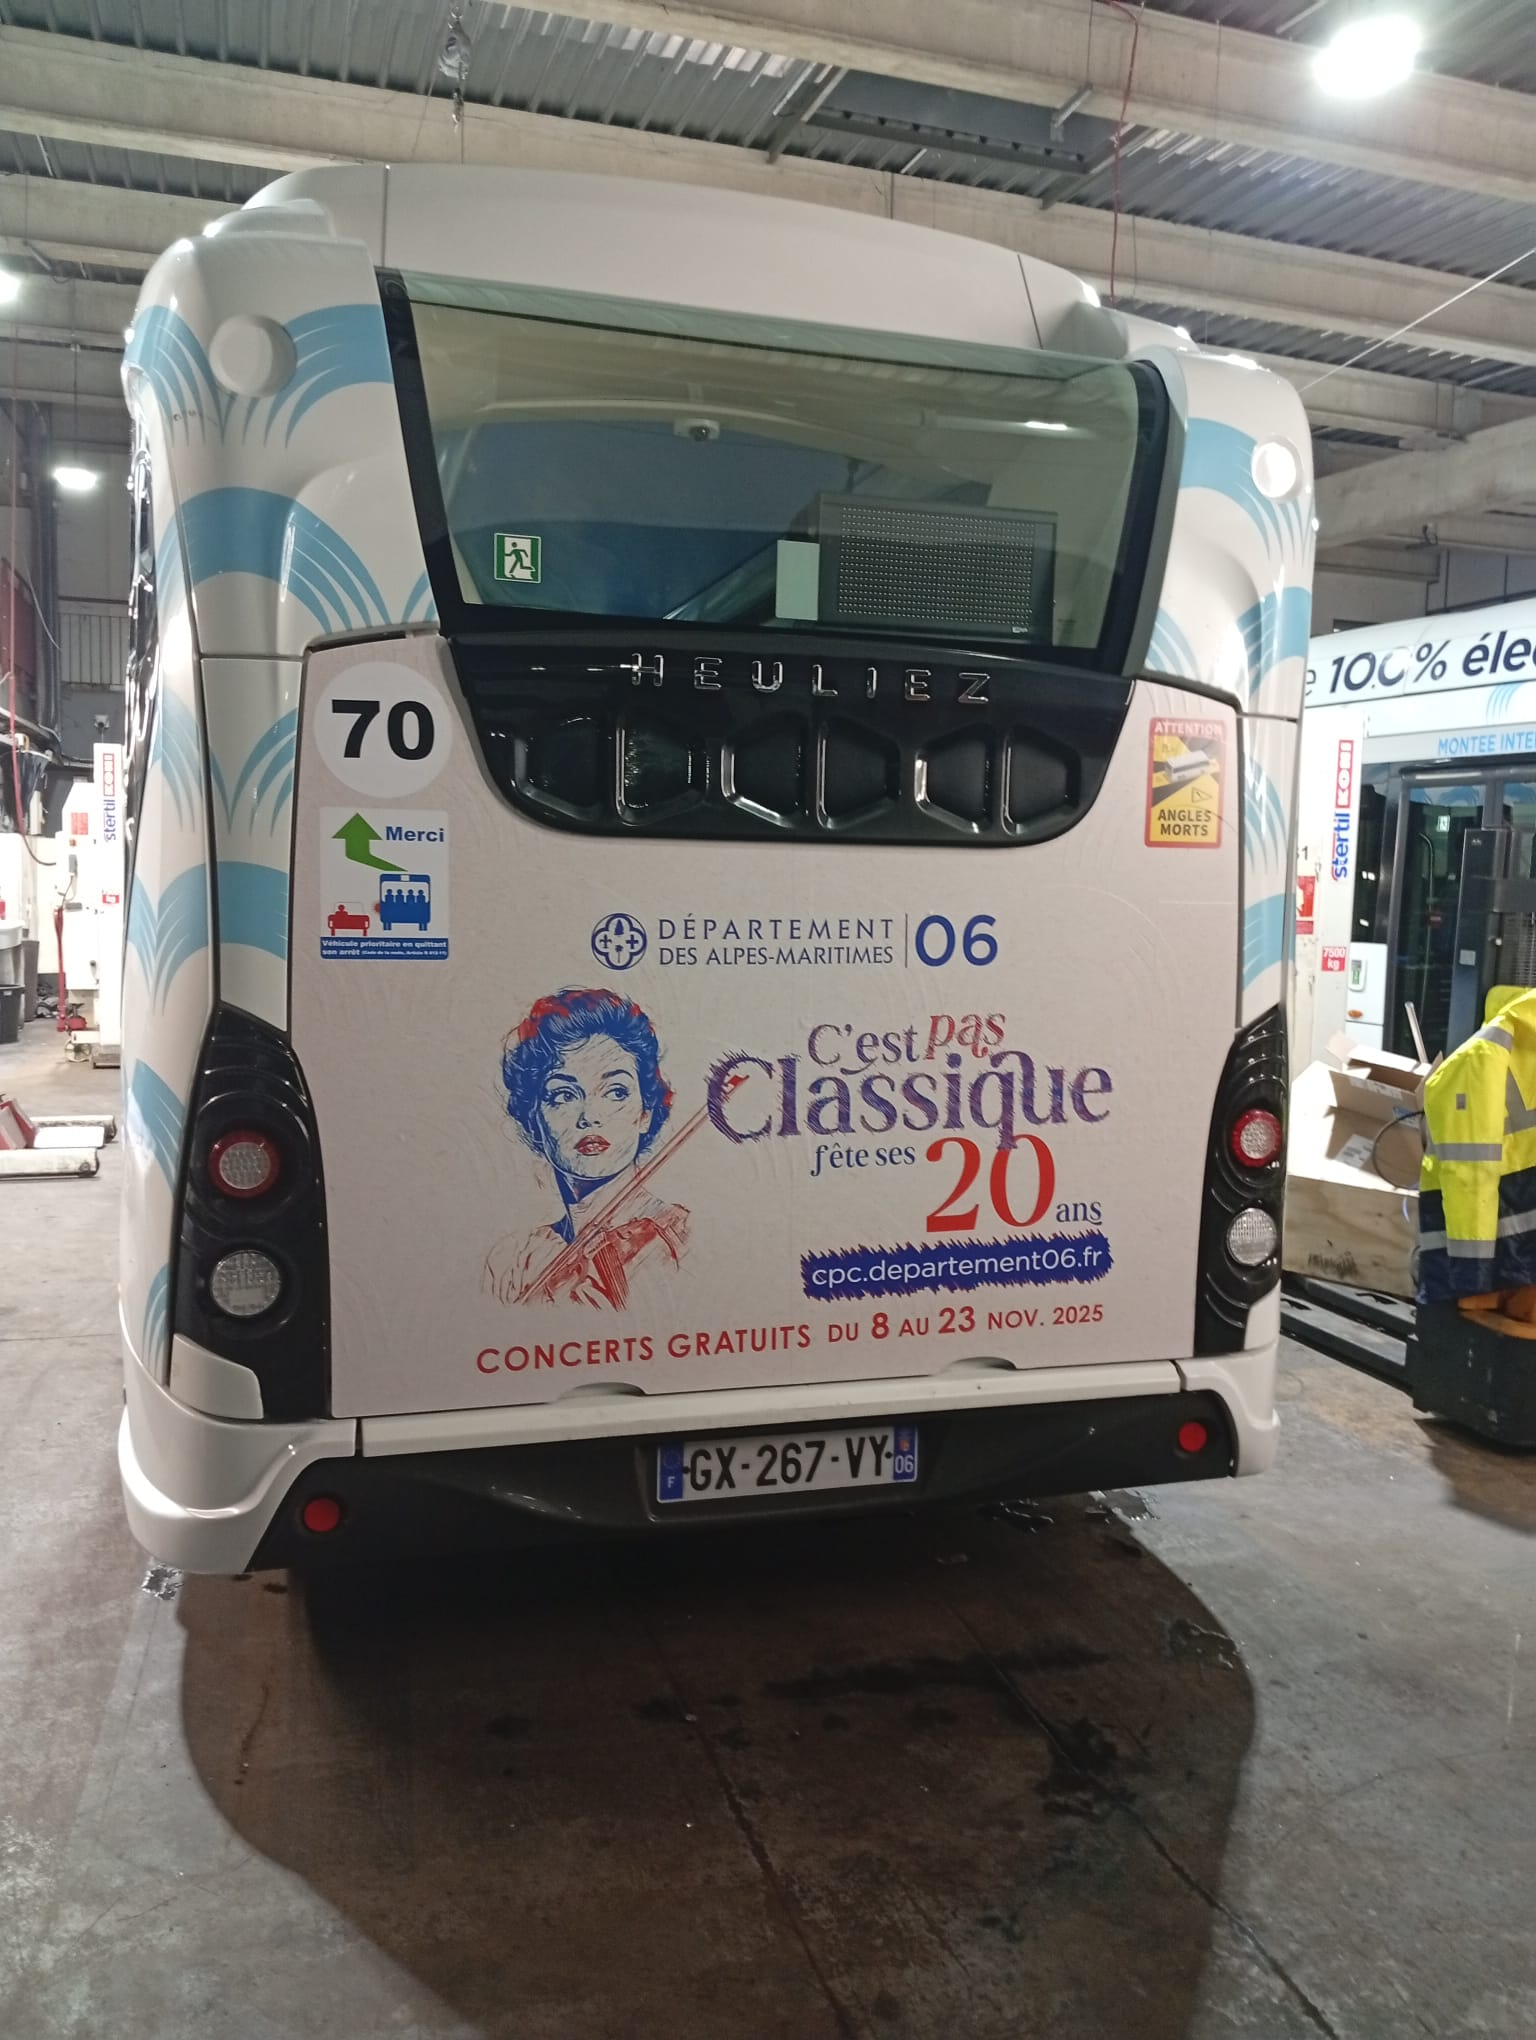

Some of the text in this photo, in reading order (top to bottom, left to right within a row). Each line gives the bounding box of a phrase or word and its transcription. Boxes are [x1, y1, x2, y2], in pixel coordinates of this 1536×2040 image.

[632, 653, 989, 703] HEULIEZ
[1330, 640, 1452, 694] 100%
[1462, 630, 1536, 677] éle
[332, 699, 435, 761] 70
[1154, 722, 1223, 736] ATTENTION
[1438, 731, 1536, 756] MONTEE INTE
[104, 799, 116, 842] stertil
[385, 826, 445, 843] Merci
[1158, 809, 1212, 822] ANGLES
[1160, 823, 1209, 836] MORTS
[1331, 812, 1350, 880] stertil
[658, 913, 893, 940] DÉPARTEMENT
[914, 914, 998, 967] 06
[659, 945, 894, 966] DES ALPES-MARITIMES
[1327, 958, 1341, 970] kg
[808, 1012, 1006, 1075] C'est pas
[704, 1050, 1114, 1150] Classique
[811, 1133, 1103, 1233] fête ses 20 ans
[811, 1247, 1103, 1289] cpc.departement06.fr
[476, 1304, 1104, 1374] CONCERTS GRATUITS DU 8 AU 23 NOV. 2025
[667, 1434, 914, 1492] F GX-267-VY 06
